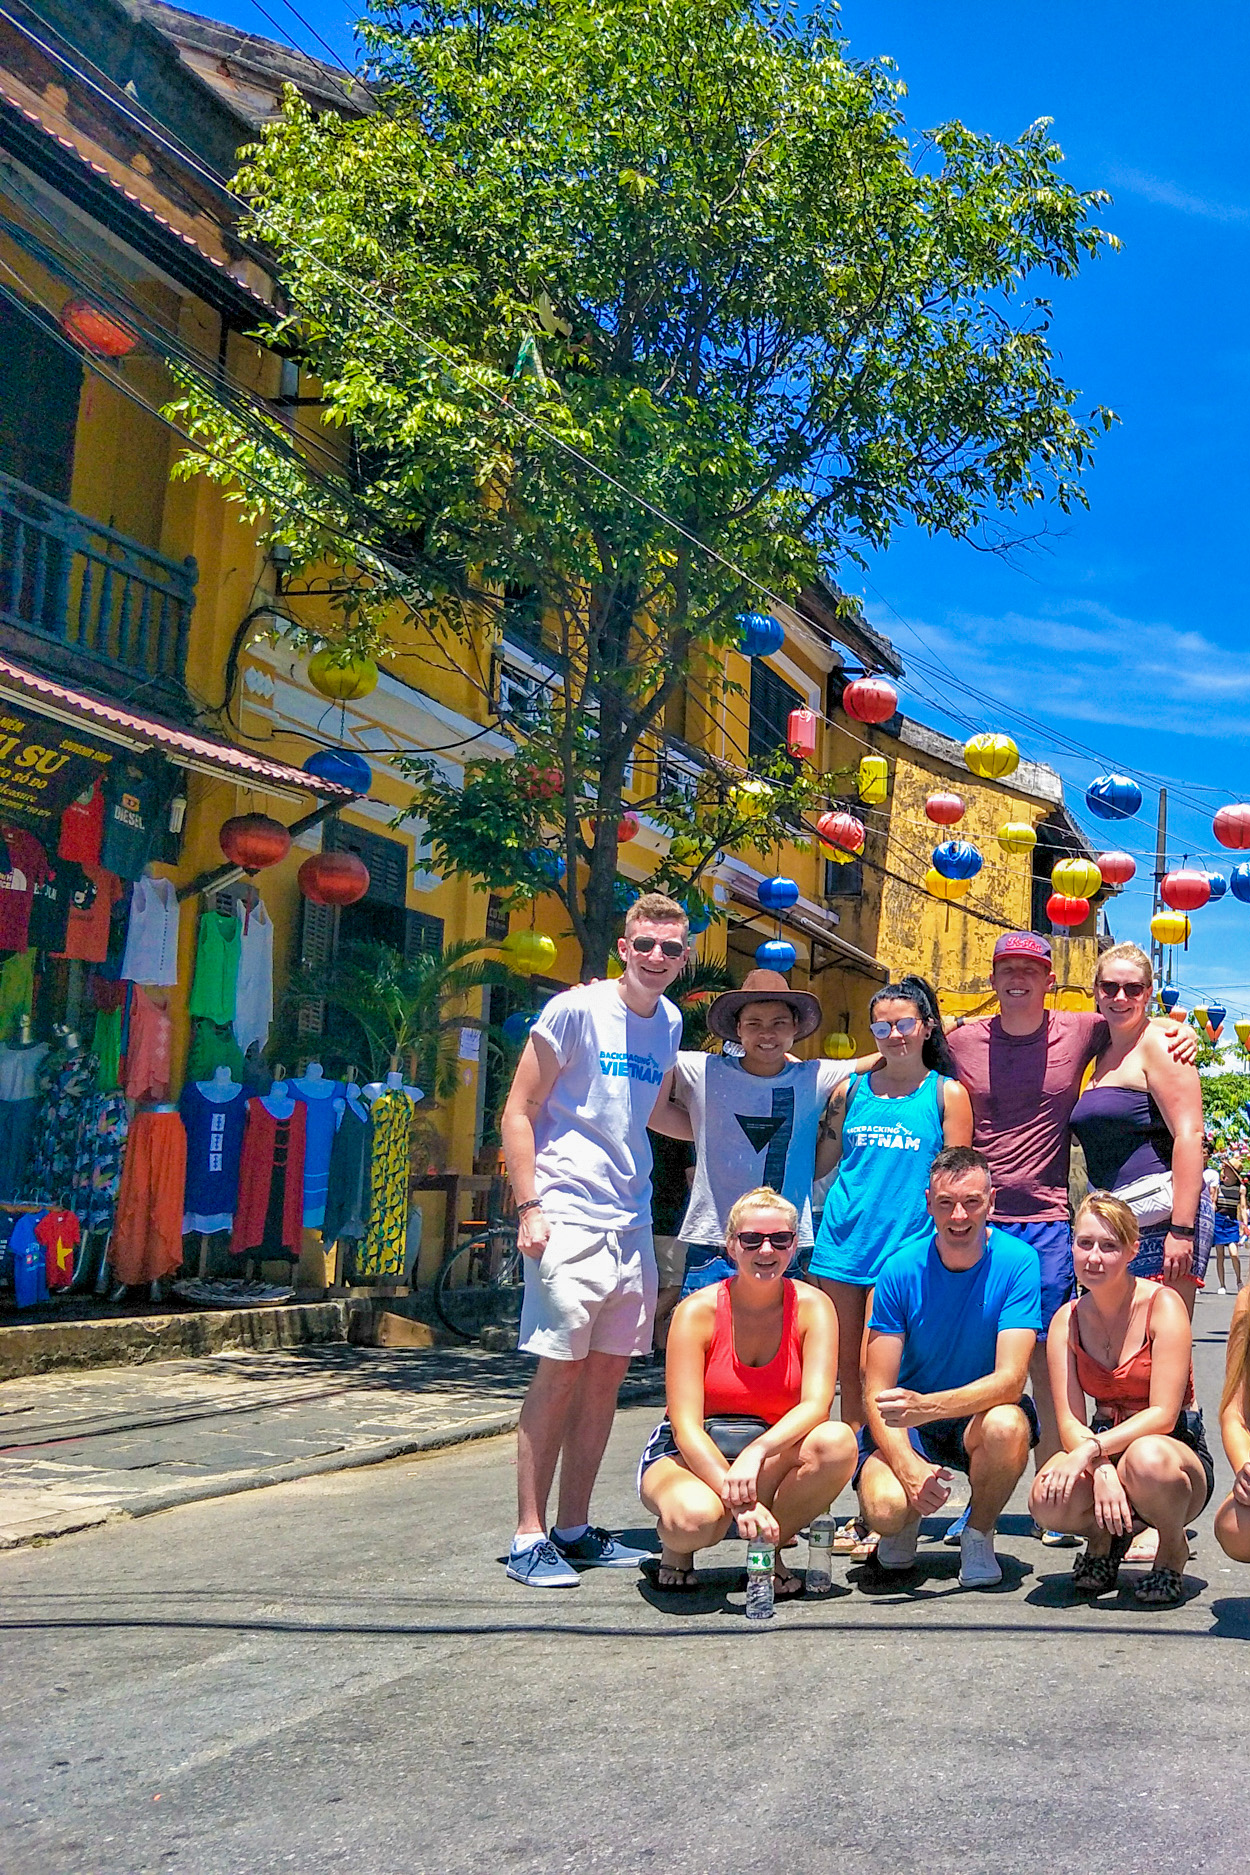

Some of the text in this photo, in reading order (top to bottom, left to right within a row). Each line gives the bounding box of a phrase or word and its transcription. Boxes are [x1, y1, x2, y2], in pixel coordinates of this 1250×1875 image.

[14, 745, 70, 774] SU
[114, 804, 145, 830] DIESEL
[600, 1051, 651, 1066] BACKPACKING
[600, 1060, 663, 1086] VIETNAM
